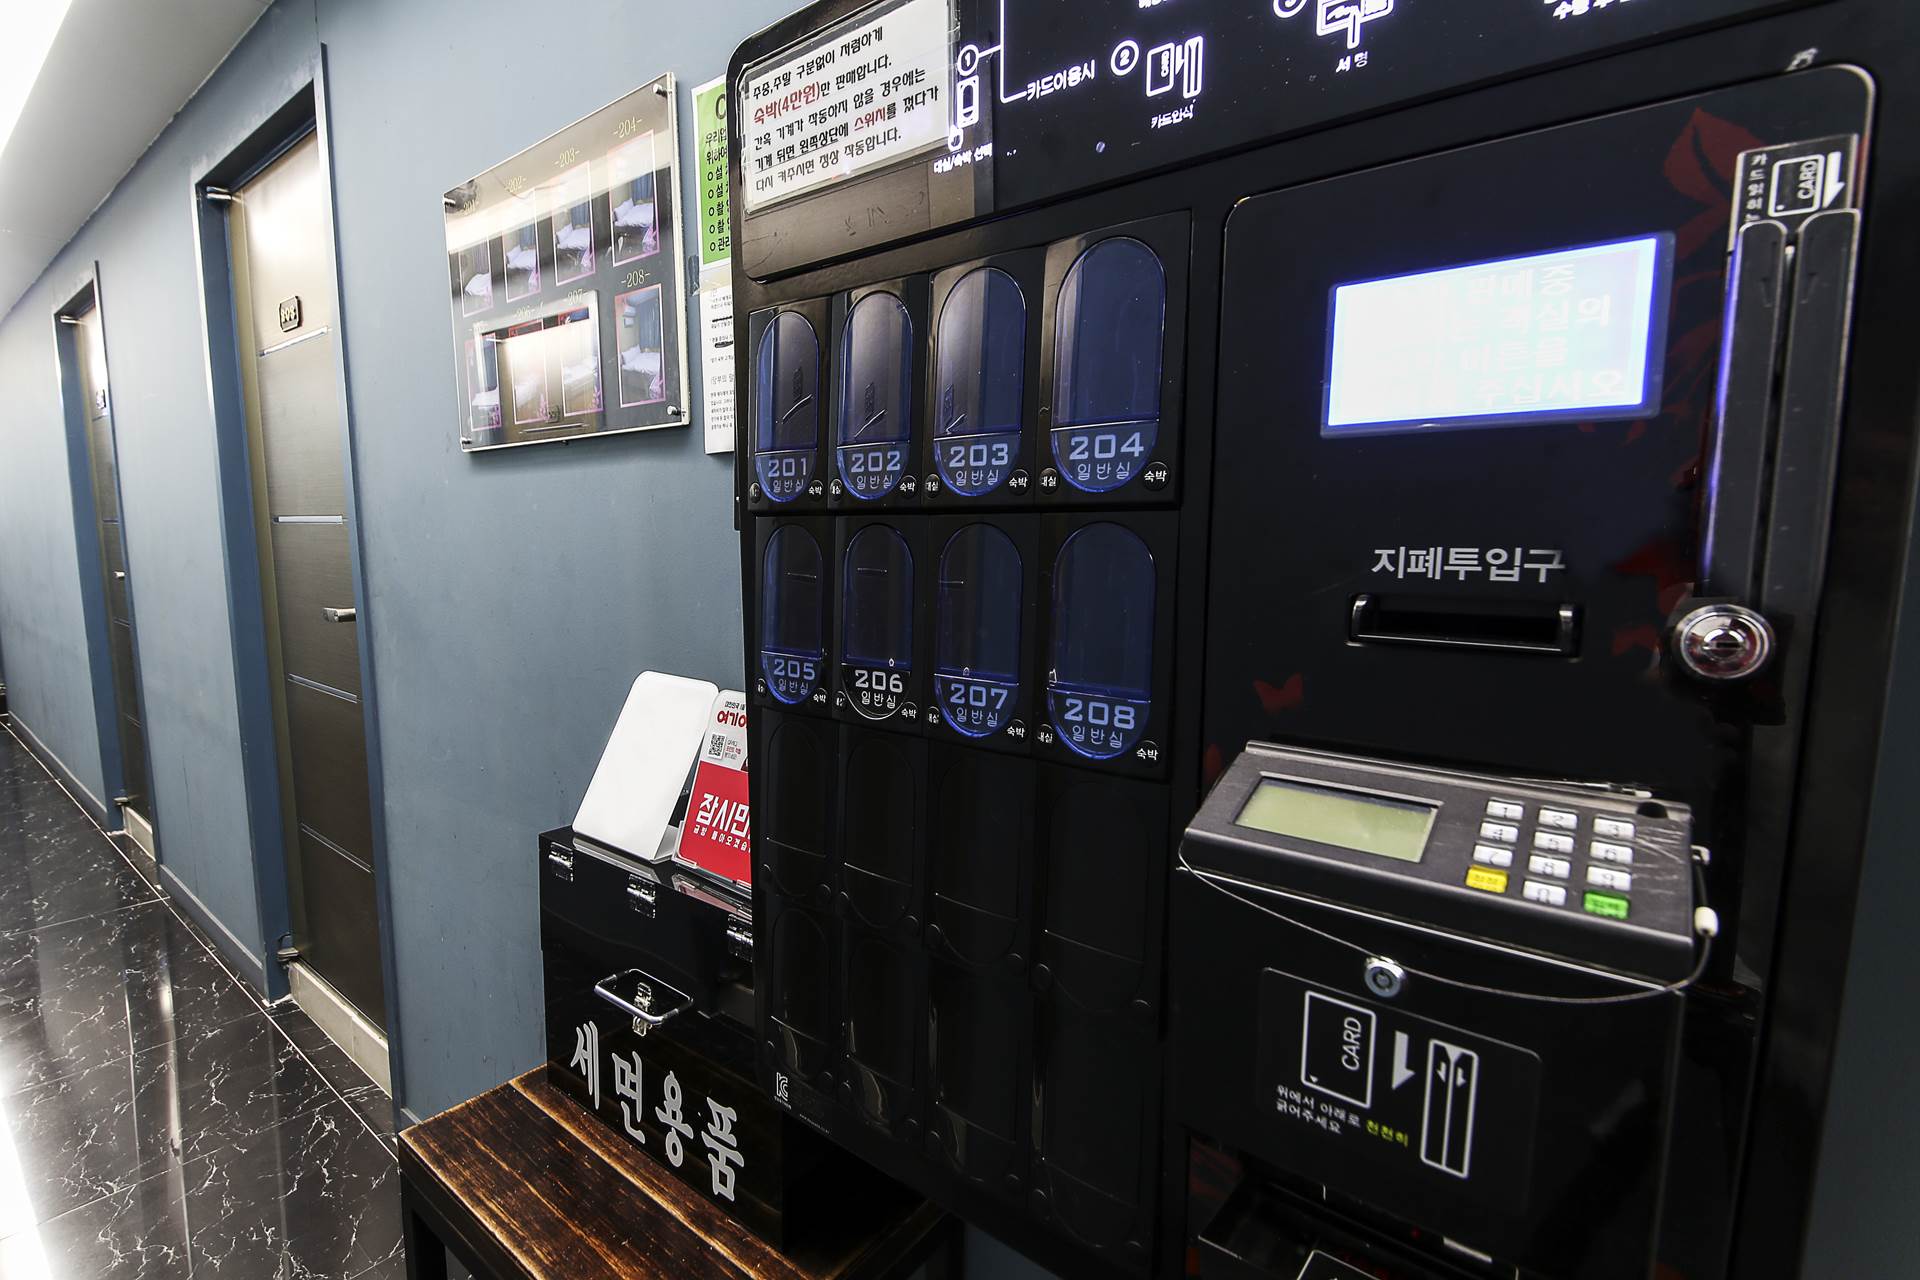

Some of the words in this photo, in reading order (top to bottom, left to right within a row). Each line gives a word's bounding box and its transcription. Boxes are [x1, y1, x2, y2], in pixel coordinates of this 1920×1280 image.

[796, 50, 835, 80] 구분없이
[1027, 59, 1096, 101] 카드이용시
[776, 118, 804, 139] 기계가
[880, 68, 926, 97] 경우에는
[705, 127, 727, 147] 우리업
[755, 154, 773, 170] 기계
[854, 102, 897, 131] 스위치를
[756, 175, 774, 191] 다시
[819, 149, 840, 169] 정상
[1797, 160, 1818, 200] CARD
[949, 443, 1009, 468] 203
[1069, 432, 1145, 461] 204
[768, 457, 807, 478] 201
[851, 450, 901, 473] 202
[1077, 461, 1131, 482] 일반실
[856, 474, 893, 490] 일반실
[900, 481, 916, 493] 숙박
[955, 469, 999, 487] 일반실
[1008, 477, 1028, 489] 숙박
[1144, 469, 1168, 483] 숙박
[808, 485, 823, 496] 숙박
[1371, 546, 1567, 583] 지폐투입구
[773, 658, 816, 681] 205
[854, 669, 903, 693] 206
[813, 692, 827, 704] 숙박
[861, 690, 896, 709] 일반실
[950, 683, 1008, 710] 207
[901, 707, 917, 719] 숙박
[956, 707, 998, 728] 일반실
[1064, 698, 1135, 730] 208
[1006, 725, 1026, 738] 숙박
[1071, 725, 1123, 749] 일반실
[1136, 748, 1160, 761] 숙박
[1341, 1017, 1361, 1070] CARD
[570, 1020, 745, 1201] 세면용품
[1277, 1084, 1315, 1109] 위에서
[1320, 1103, 1361, 1128] 아래로
